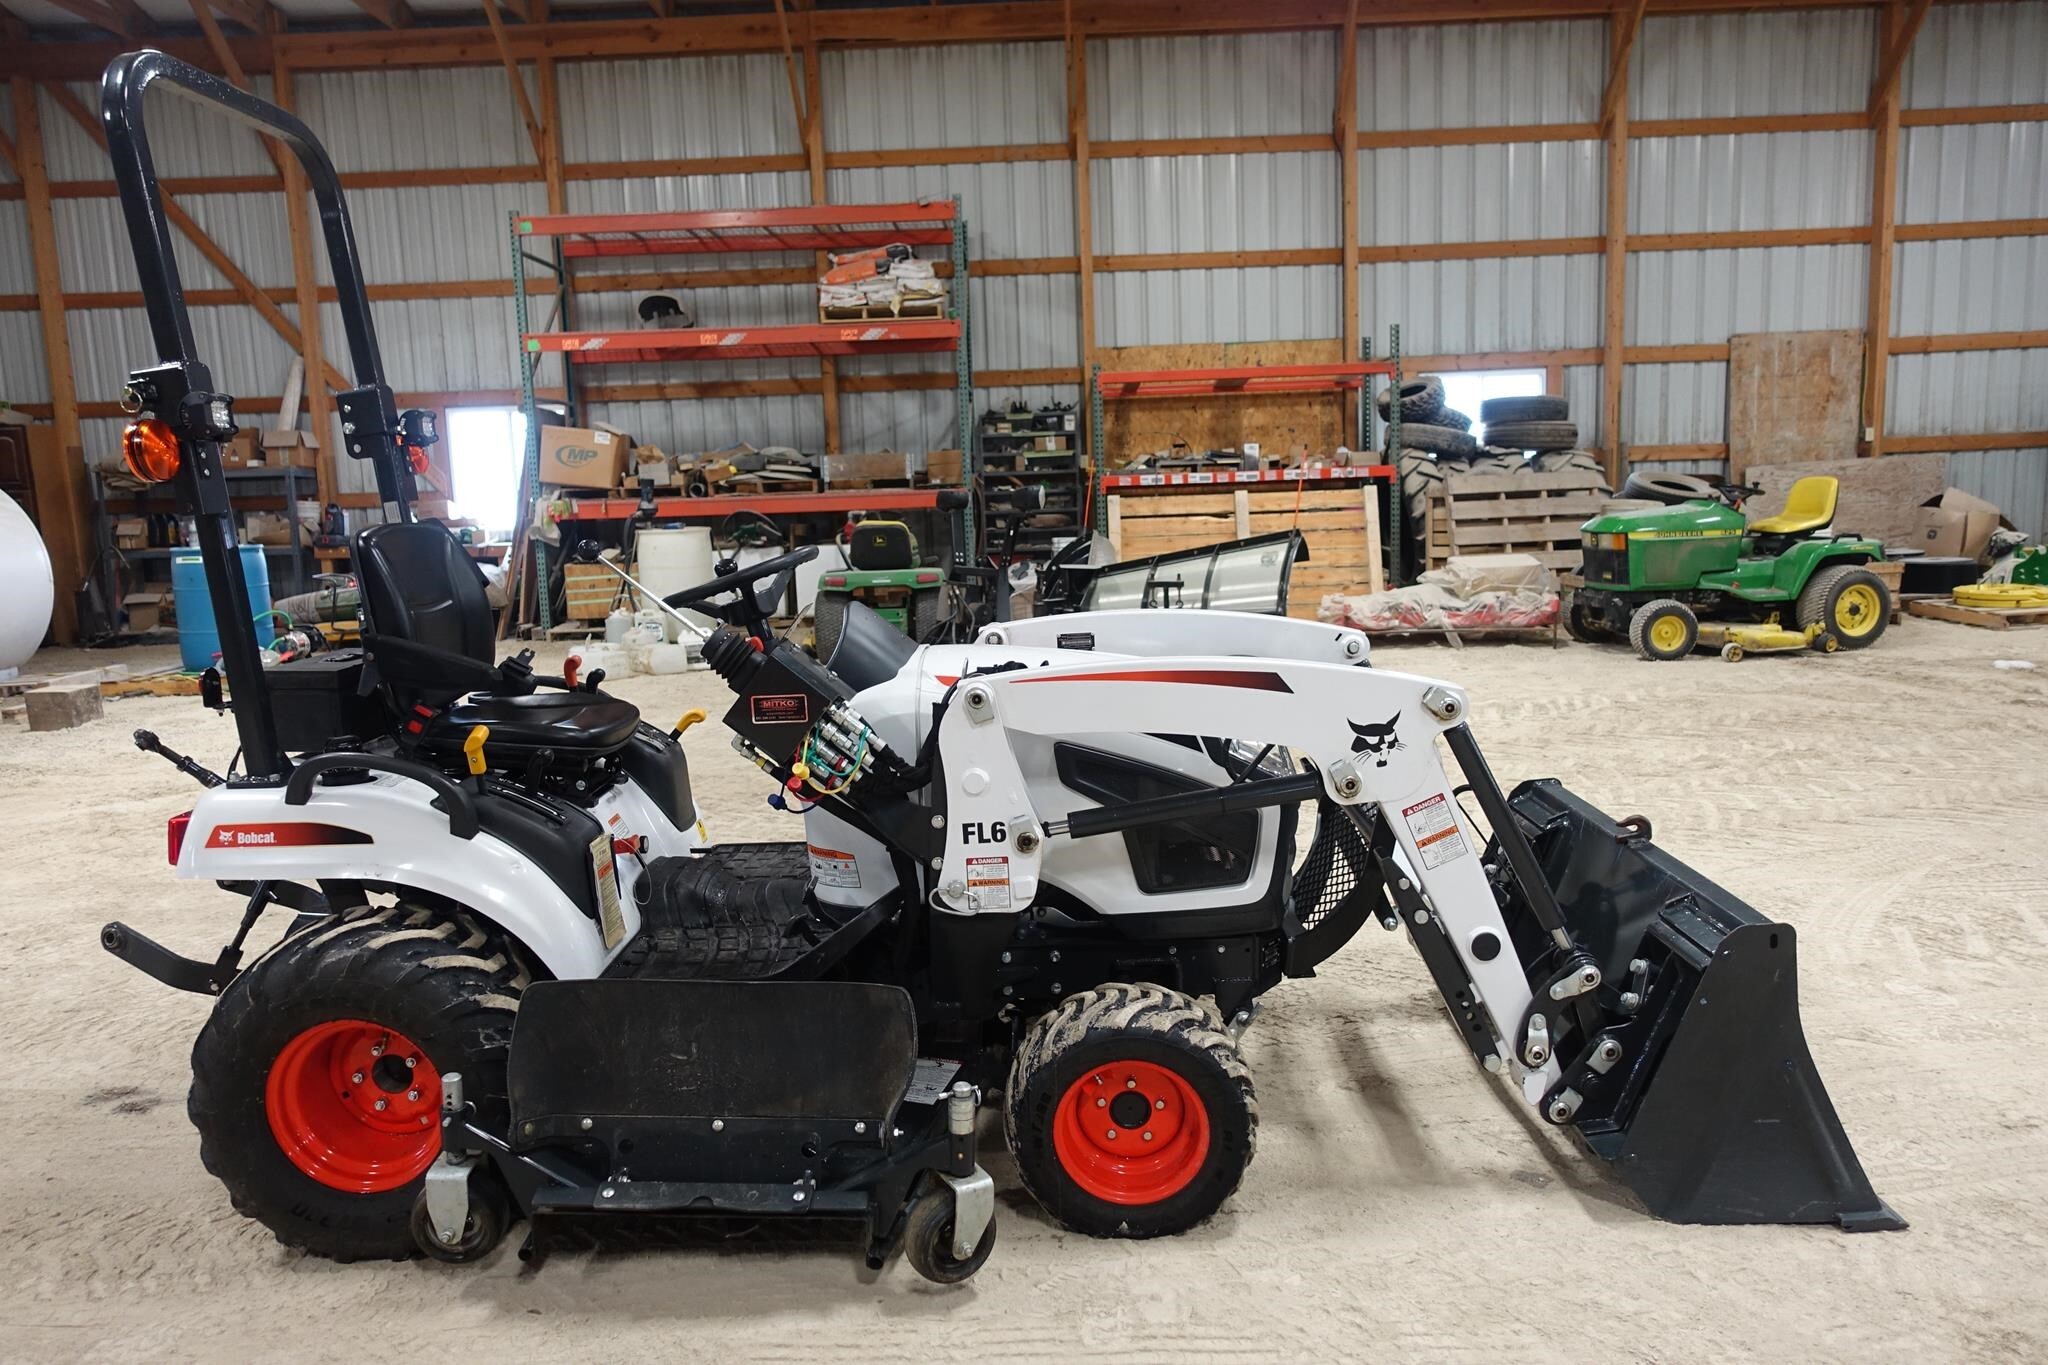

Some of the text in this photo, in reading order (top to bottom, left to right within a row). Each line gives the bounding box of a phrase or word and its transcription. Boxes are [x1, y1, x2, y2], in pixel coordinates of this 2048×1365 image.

[763, 699, 795, 709] MITKO
[1412, 796, 1441, 812] DANGER
[237, 831, 275, 844] Bobcat
[961, 821, 1007, 845] FL6
[1426, 828, 1455, 844] WARNING
[978, 857, 1003, 865] DANGER
